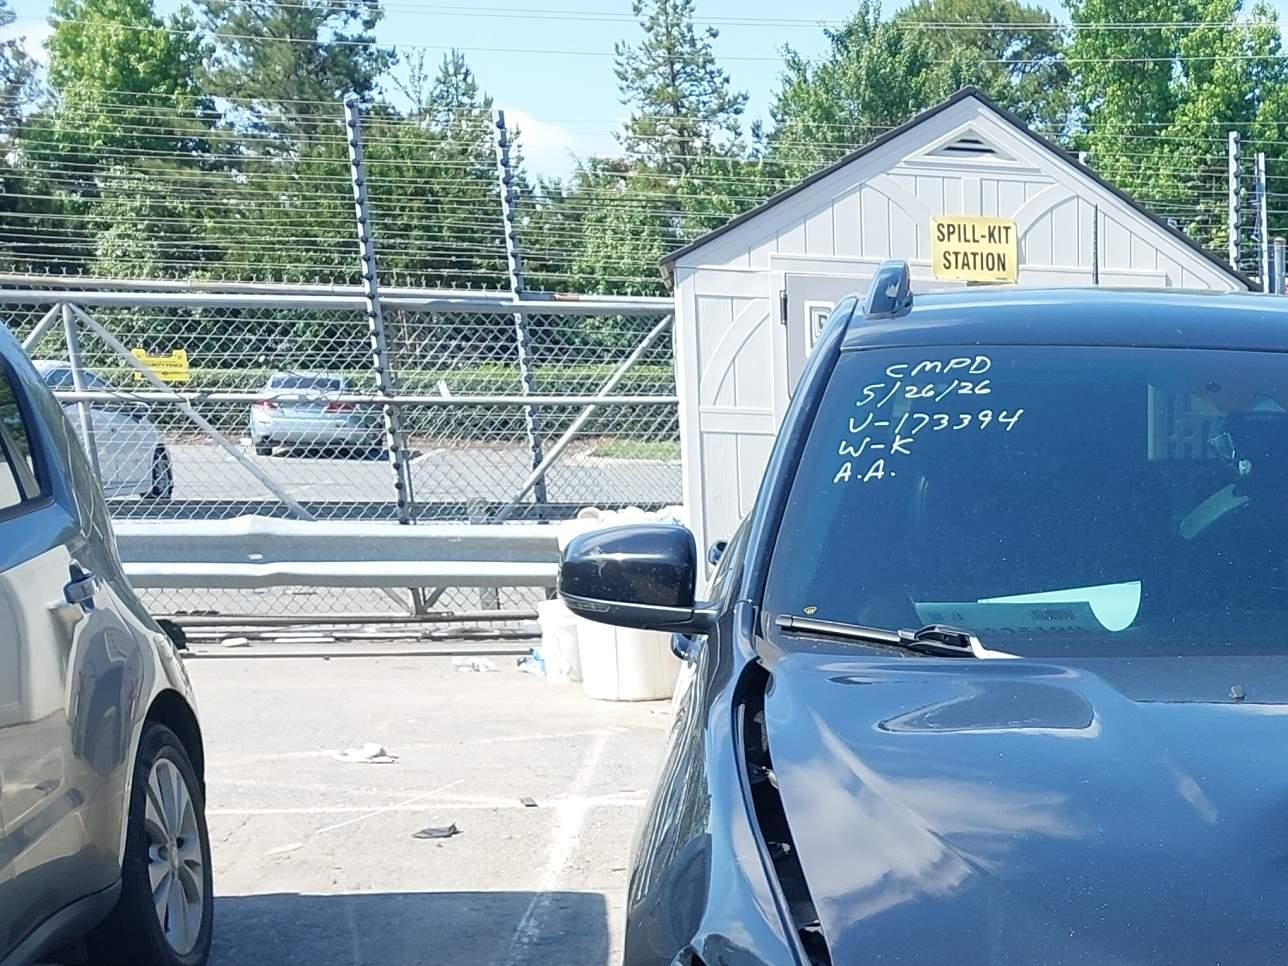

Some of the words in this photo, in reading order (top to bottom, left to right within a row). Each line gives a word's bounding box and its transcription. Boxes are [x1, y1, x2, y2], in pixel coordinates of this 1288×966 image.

[936, 222, 1012, 245] SPILL-KIT
[942, 250, 1006, 272] STATION
[886, 356, 992, 378] CMPD
[856, 379, 992, 408] 5/26/26
[838, 434, 914, 457] W-K
